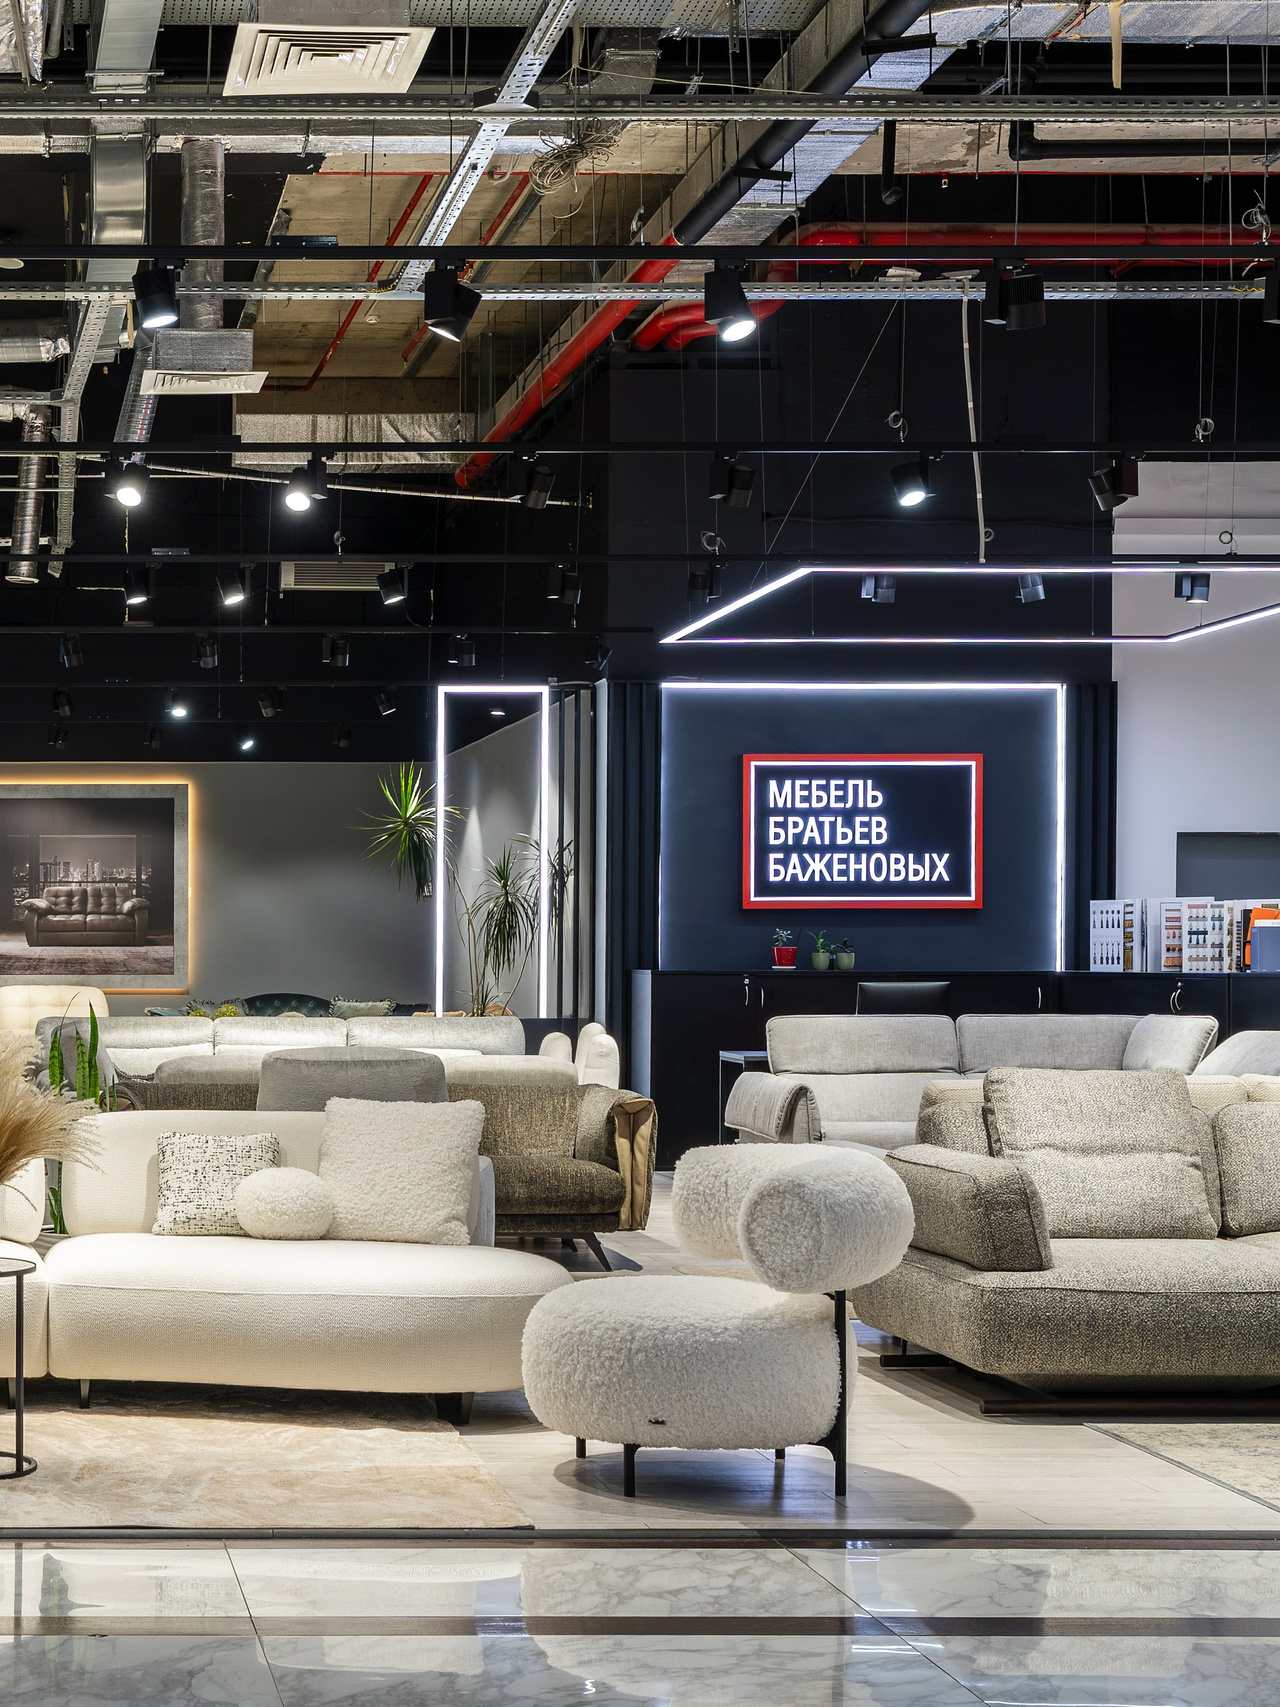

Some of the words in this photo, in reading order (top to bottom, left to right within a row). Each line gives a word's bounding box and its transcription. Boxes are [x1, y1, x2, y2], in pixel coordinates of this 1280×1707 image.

[768, 779, 884, 809] МЕБЕЛЬ
[768, 816, 889, 845] БРАТЬЕВ
[768, 853, 950, 882] БАЖЕНОВЫХ
